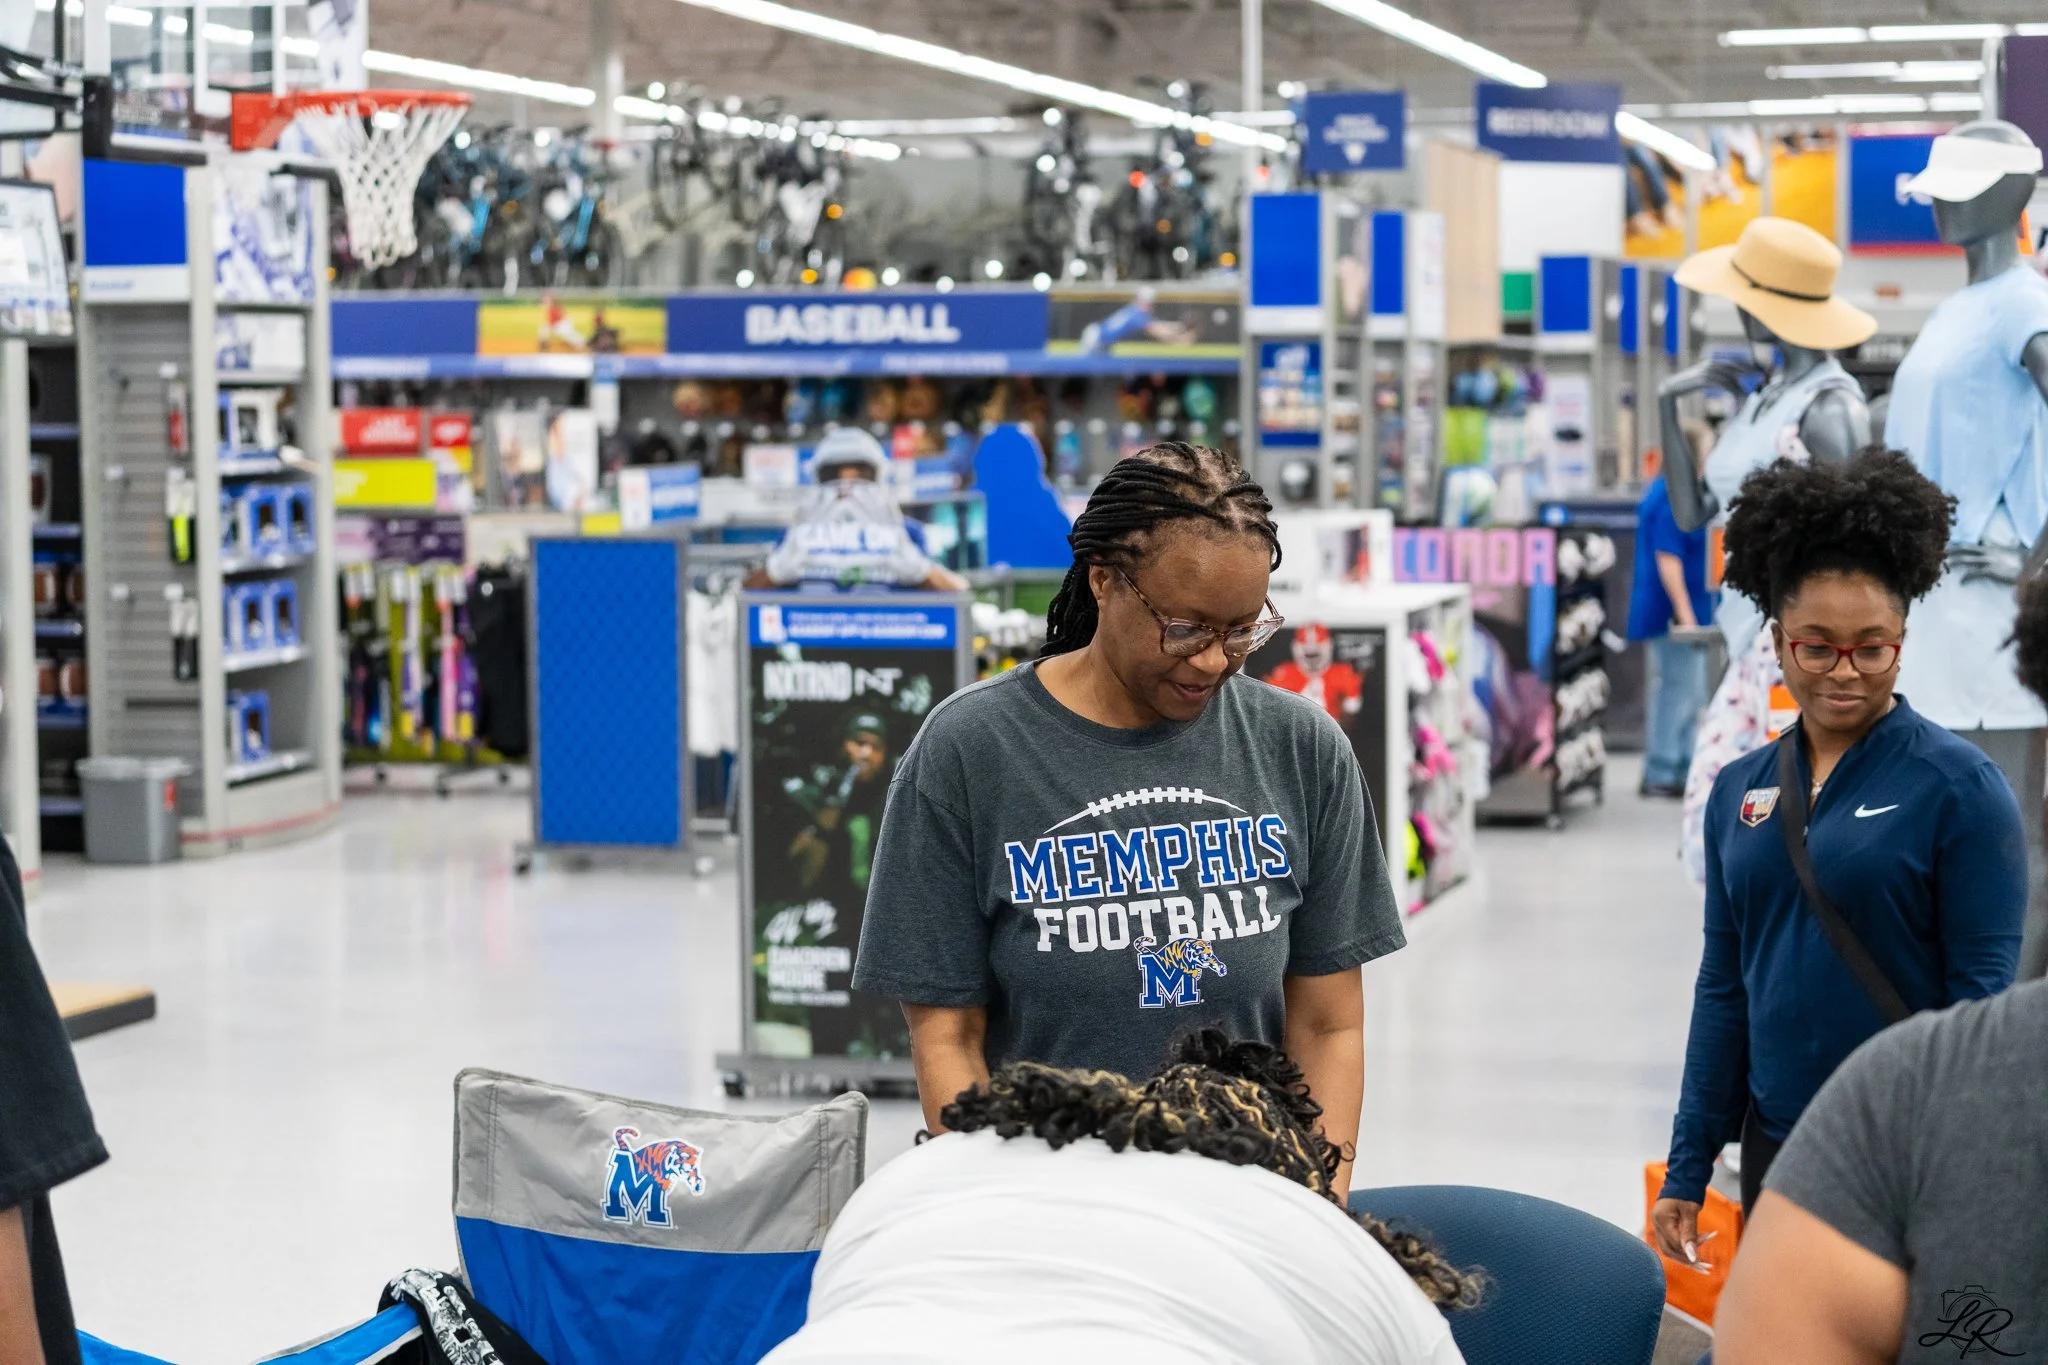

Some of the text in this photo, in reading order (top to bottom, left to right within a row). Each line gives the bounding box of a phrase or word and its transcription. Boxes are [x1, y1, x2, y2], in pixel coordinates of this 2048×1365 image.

[745, 304, 961, 344] BASEBALL
[1004, 814, 1292, 904] MEMPHIS
[1034, 886, 1282, 952] FOOTBALL
[1138, 951, 1202, 1009] M
[600, 1145, 674, 1229] M
